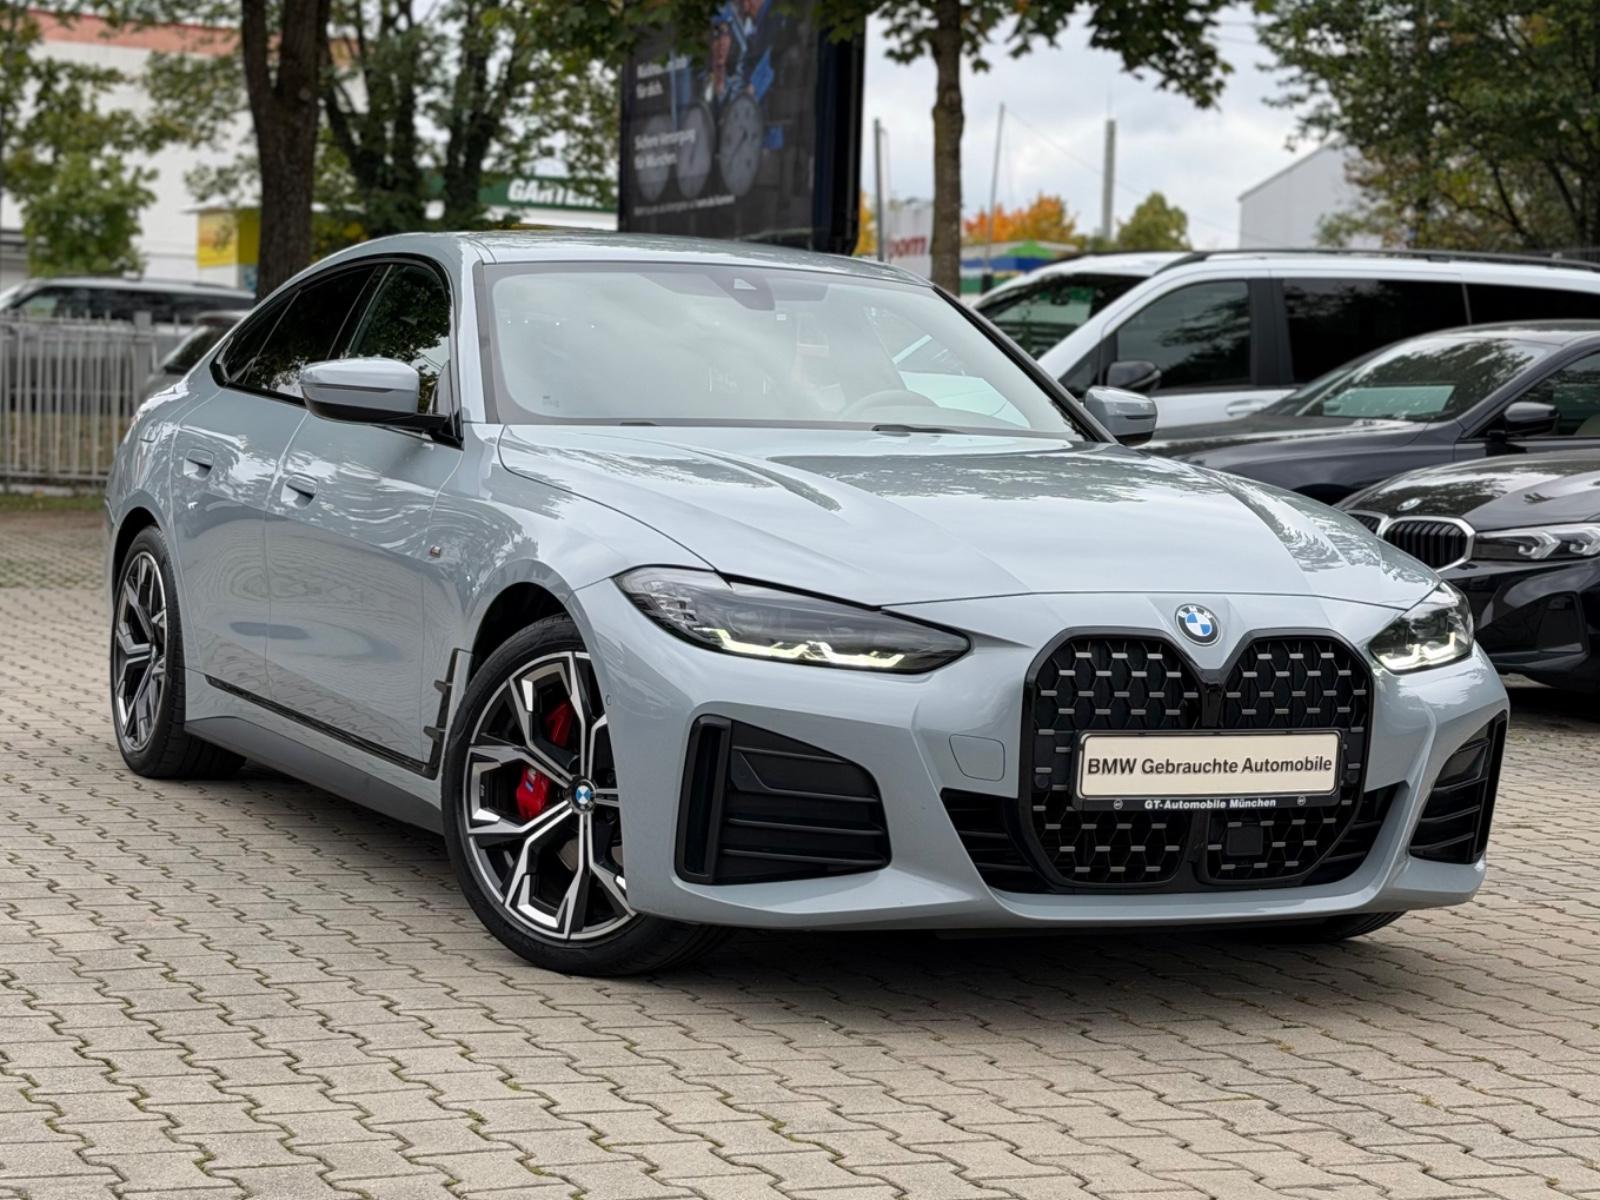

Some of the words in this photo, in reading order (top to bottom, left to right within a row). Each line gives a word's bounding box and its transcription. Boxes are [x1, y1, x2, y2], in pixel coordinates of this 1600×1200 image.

[1178, 605, 1213, 618] BMW
[1087, 758, 1137, 775] BMW
[1141, 757, 1238, 775] Gebrauchte
[1241, 755, 1333, 774] Automobile
[1144, 799, 1227, 810] GT-Automobile
[1229, 798, 1276, 809] München
